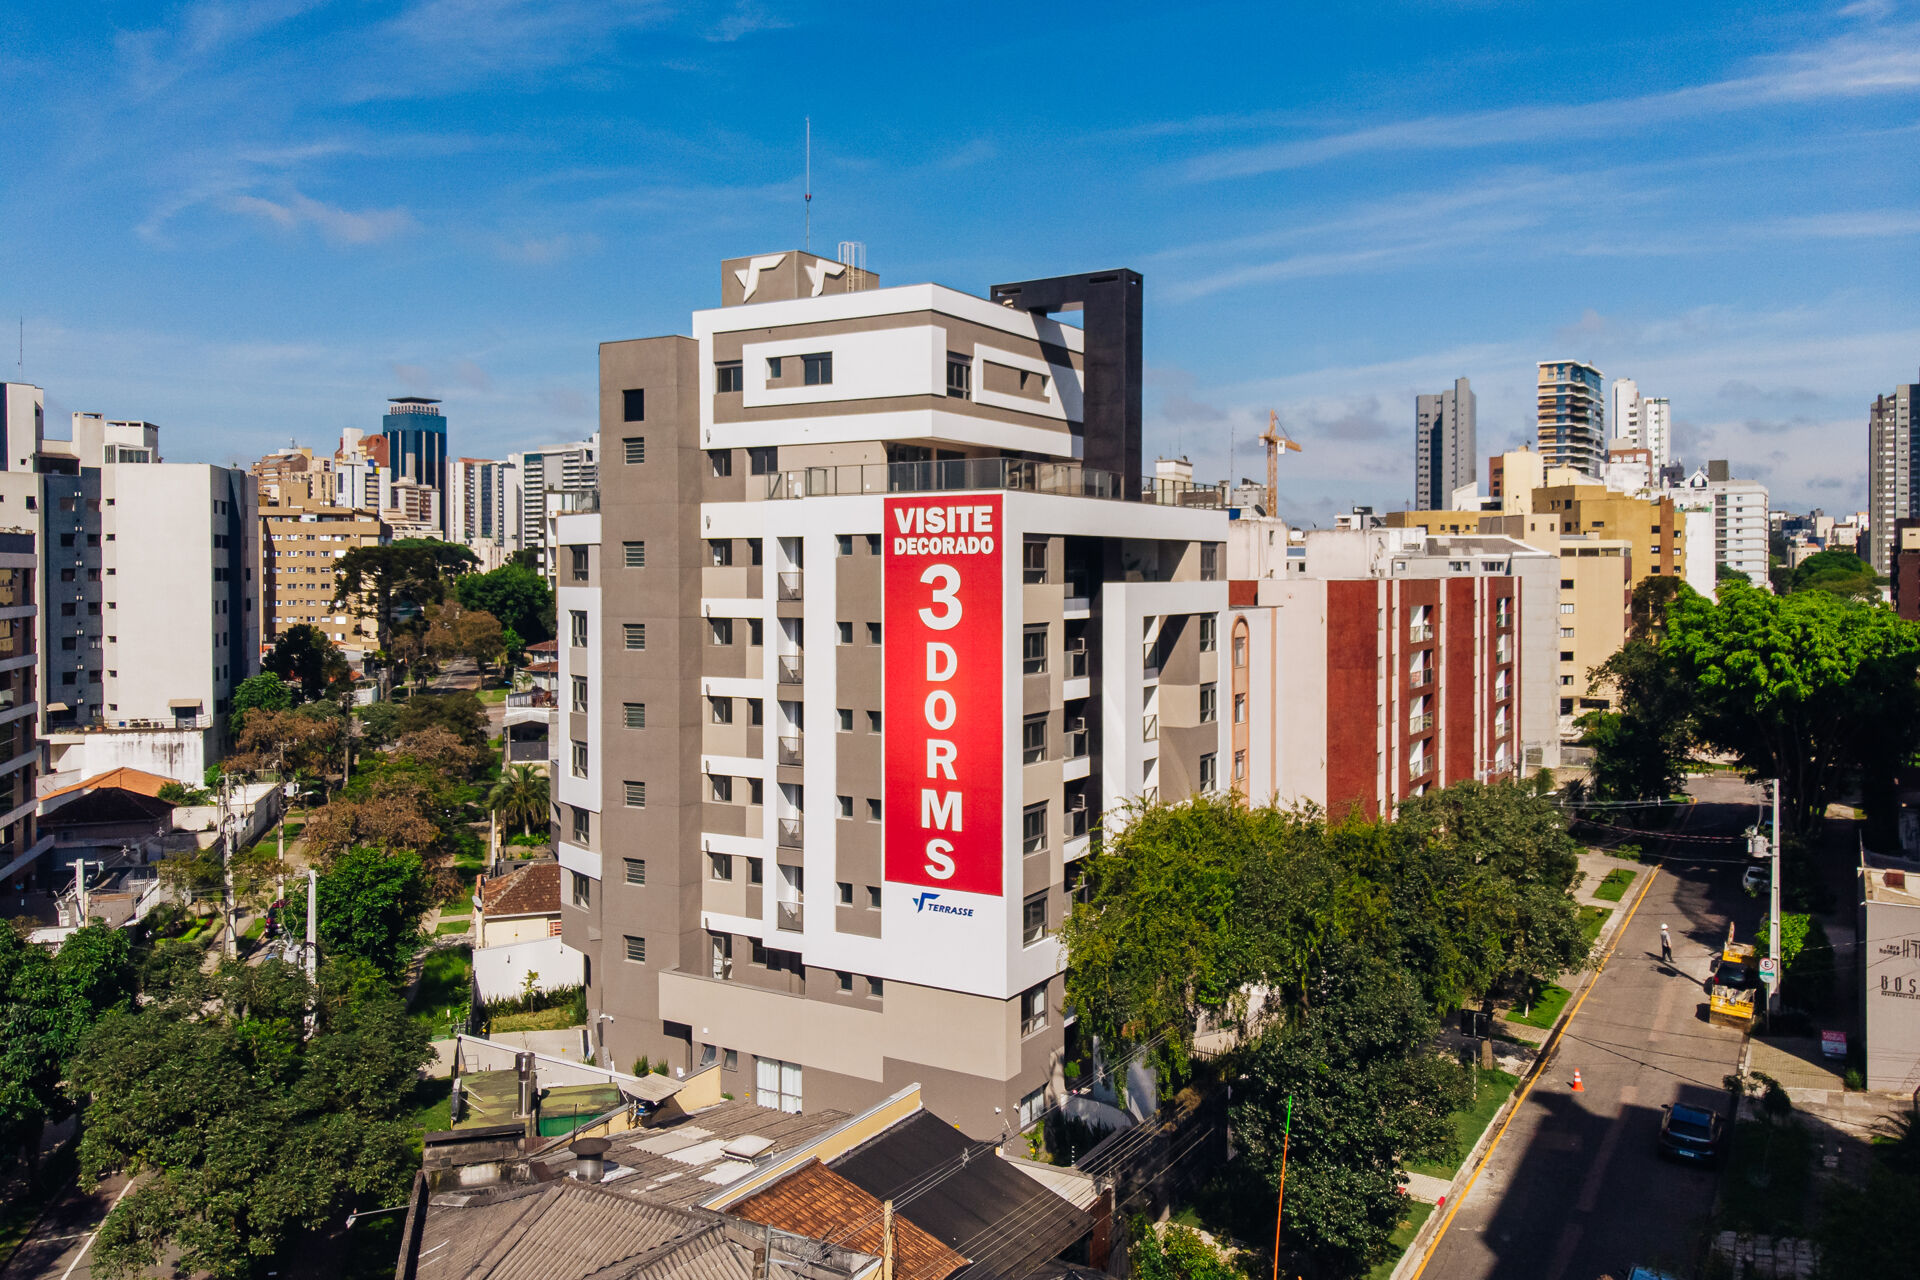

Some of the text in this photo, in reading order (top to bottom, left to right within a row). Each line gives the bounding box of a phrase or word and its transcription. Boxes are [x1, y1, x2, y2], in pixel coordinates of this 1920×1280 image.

[894, 505, 993, 534] VISITE
[894, 536, 994, 555] DECORADO
[918, 563, 963, 880] 3 DORMS
[928, 903, 974, 917] TERRASSE
